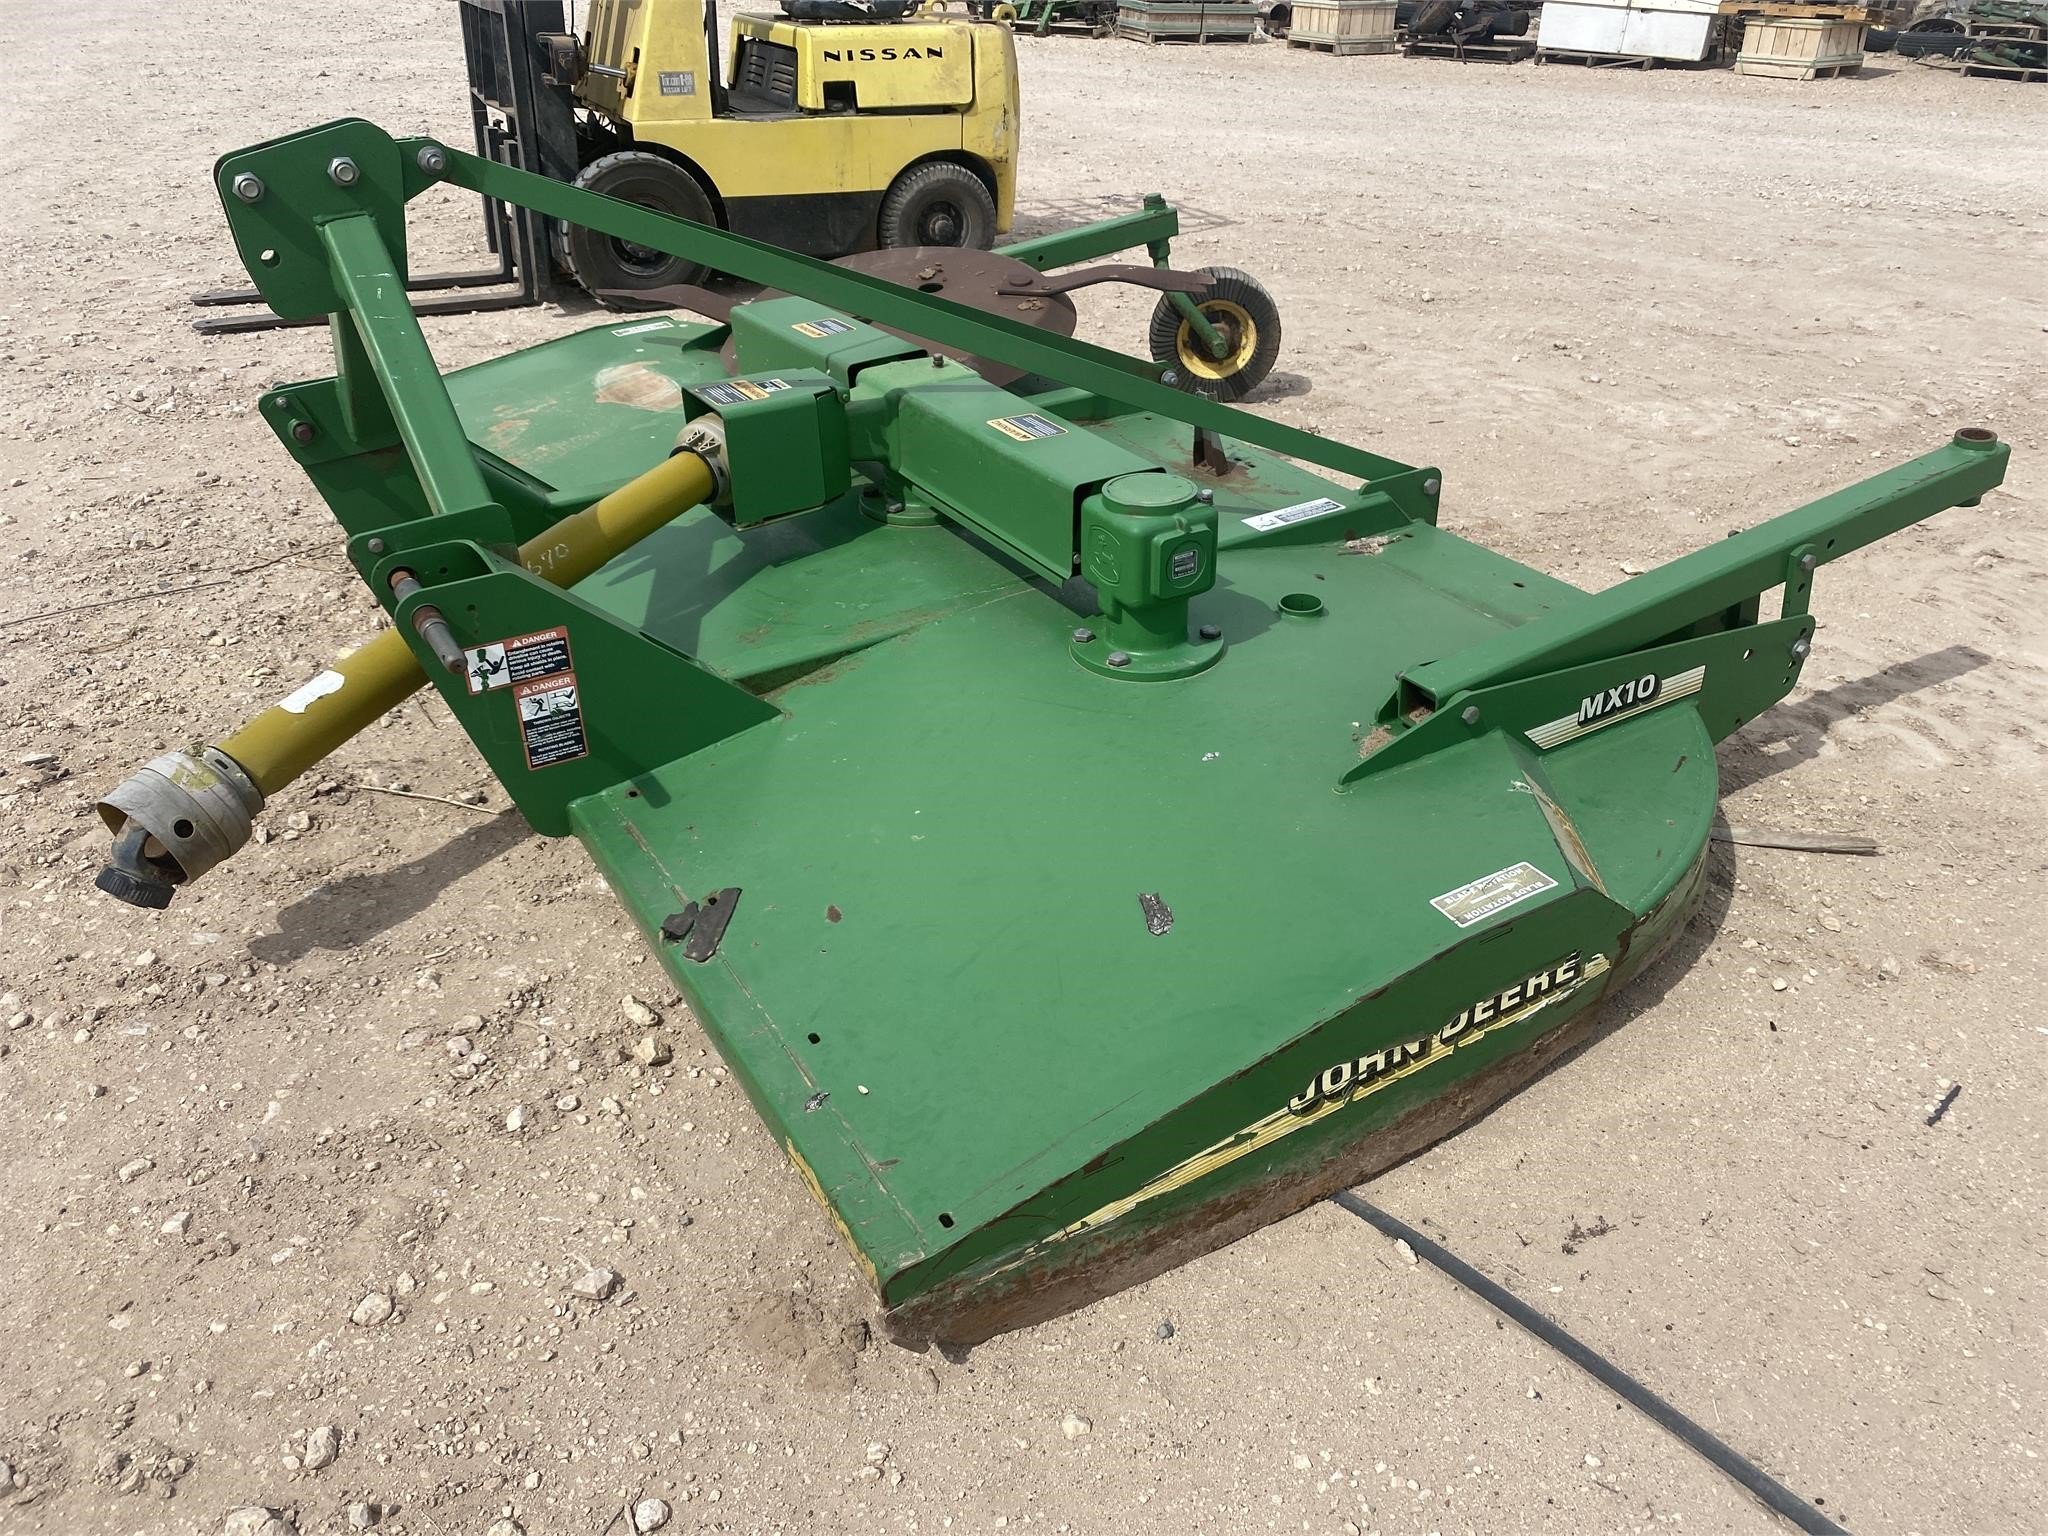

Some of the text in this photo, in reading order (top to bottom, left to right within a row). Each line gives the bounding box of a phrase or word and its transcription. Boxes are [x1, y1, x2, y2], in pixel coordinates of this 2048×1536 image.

[823, 47, 943, 62] NISSAN
[522, 631, 557, 645] DANGER
[532, 677, 571, 692] DANGER
[1577, 673, 1658, 723] MX10
[1463, 881, 1544, 920] BLADE ROTATION
[1289, 951, 1583, 1113] JOHN DEERE
